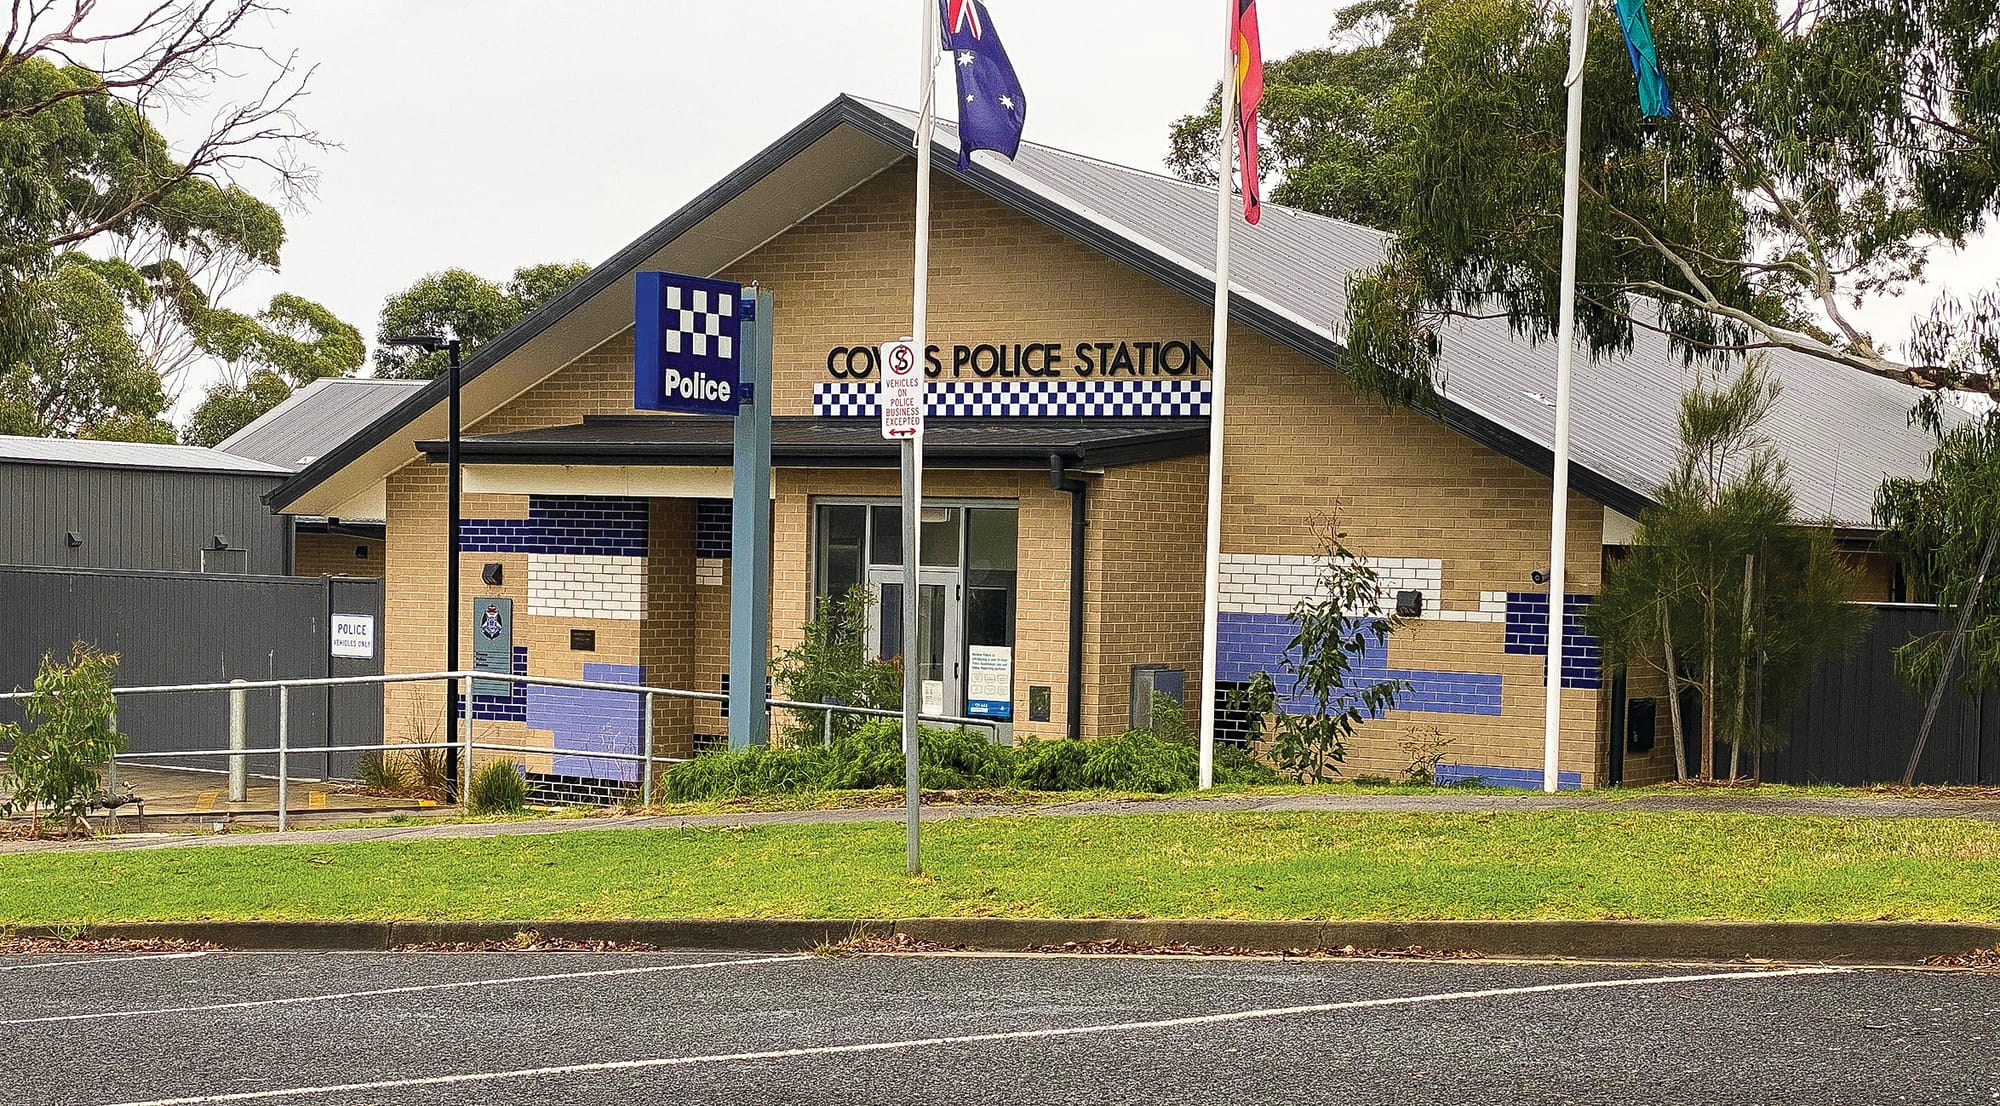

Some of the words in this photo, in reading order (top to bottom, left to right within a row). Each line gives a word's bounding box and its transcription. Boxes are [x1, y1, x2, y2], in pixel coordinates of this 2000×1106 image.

[827, 344, 942, 379] COS
[953, 343, 1061, 377] POLICE
[1074, 340, 1214, 377] STATION
[665, 368, 731, 402] Police
[886, 378, 919, 388] VEHICLES
[897, 388, 908, 397] ON
[890, 397, 915, 407] POLICE
[885, 407, 920, 417] BUSINESS
[885, 416, 921, 427] EXCEPTED
[337, 623, 367, 636] POLICE
